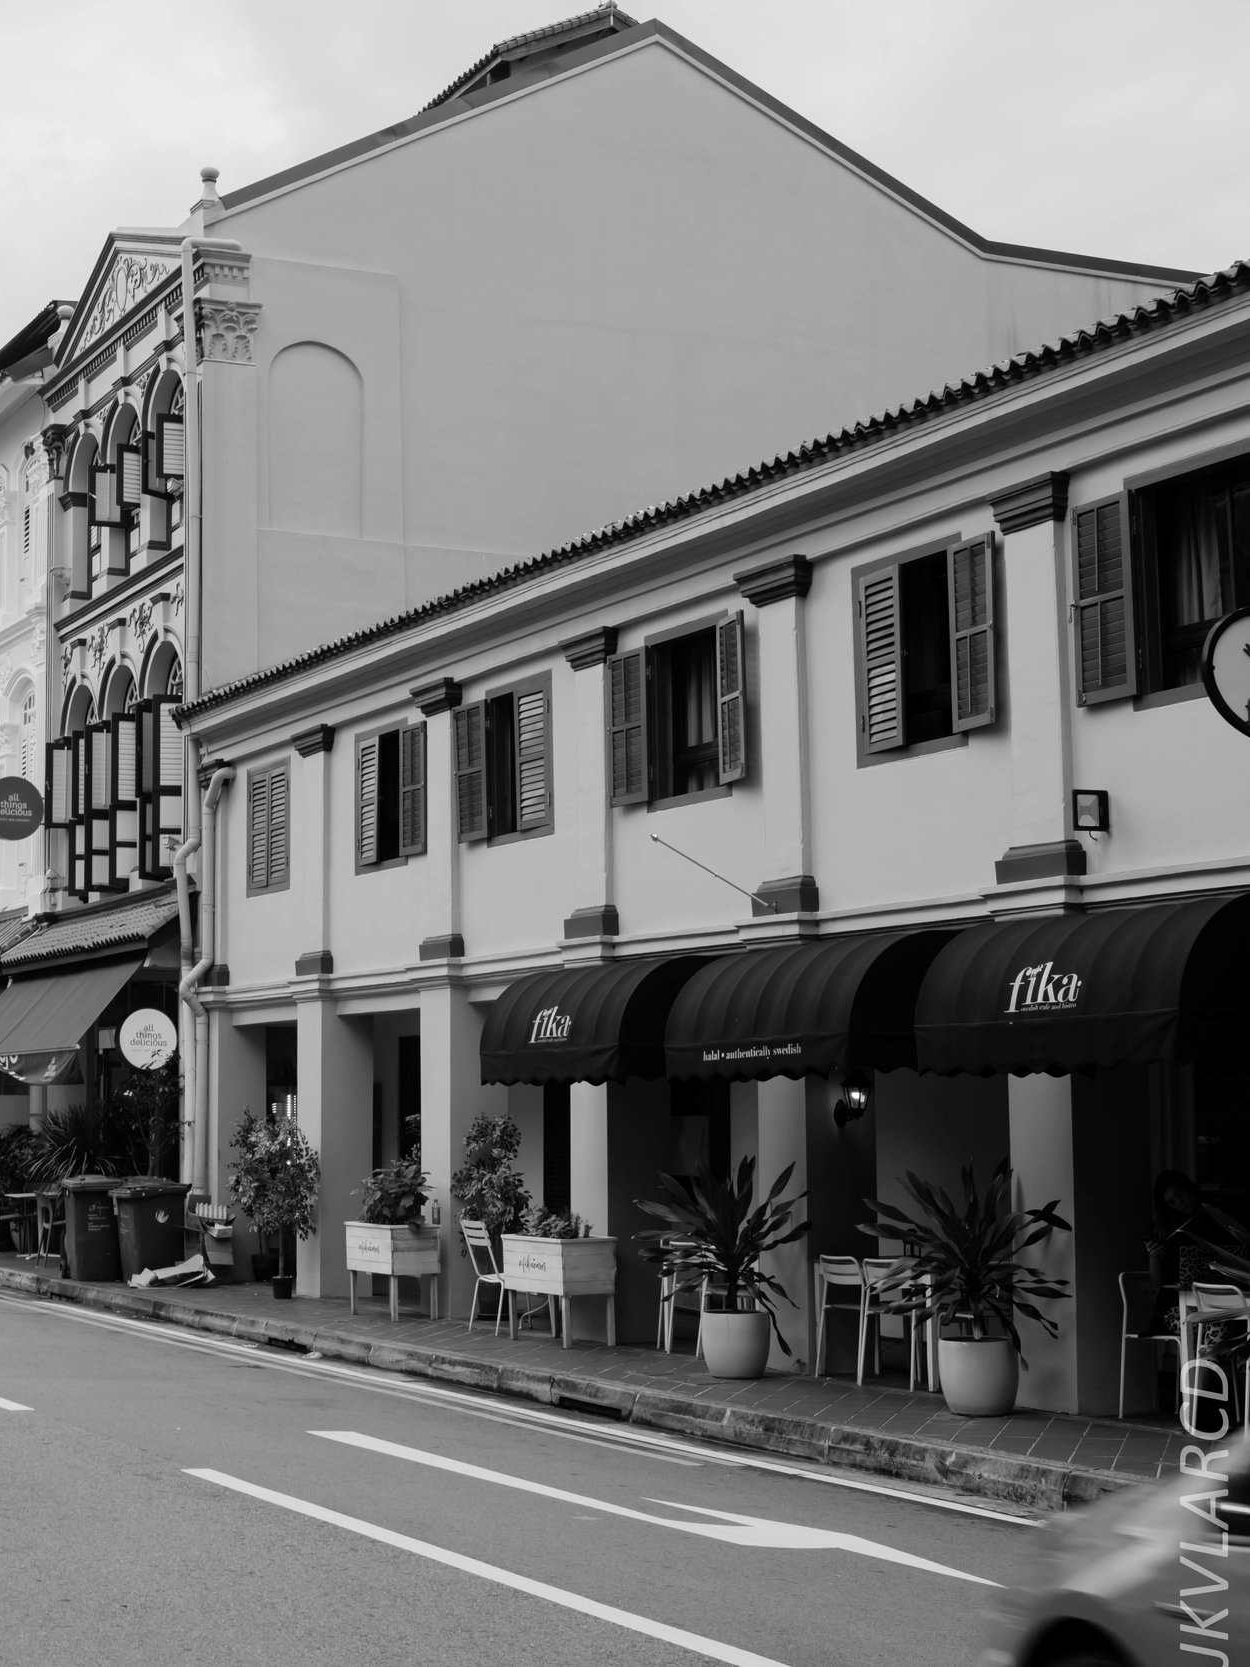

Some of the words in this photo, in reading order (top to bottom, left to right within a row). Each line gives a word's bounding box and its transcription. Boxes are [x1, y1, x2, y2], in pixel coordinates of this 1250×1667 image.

[8, 793, 20, 801] all
[0, 800, 27, 811] things
[1004, 961, 1082, 1013] fika
[143, 1024, 154, 1032] all
[528, 1005, 572, 1044] fika
[136, 1031, 162, 1040] things
[130, 1038, 167, 1046] delicious
[703, 1049, 720, 1061] halal
[725, 1045, 770, 1060] authentically
[773, 1043, 802, 1055] swedish
